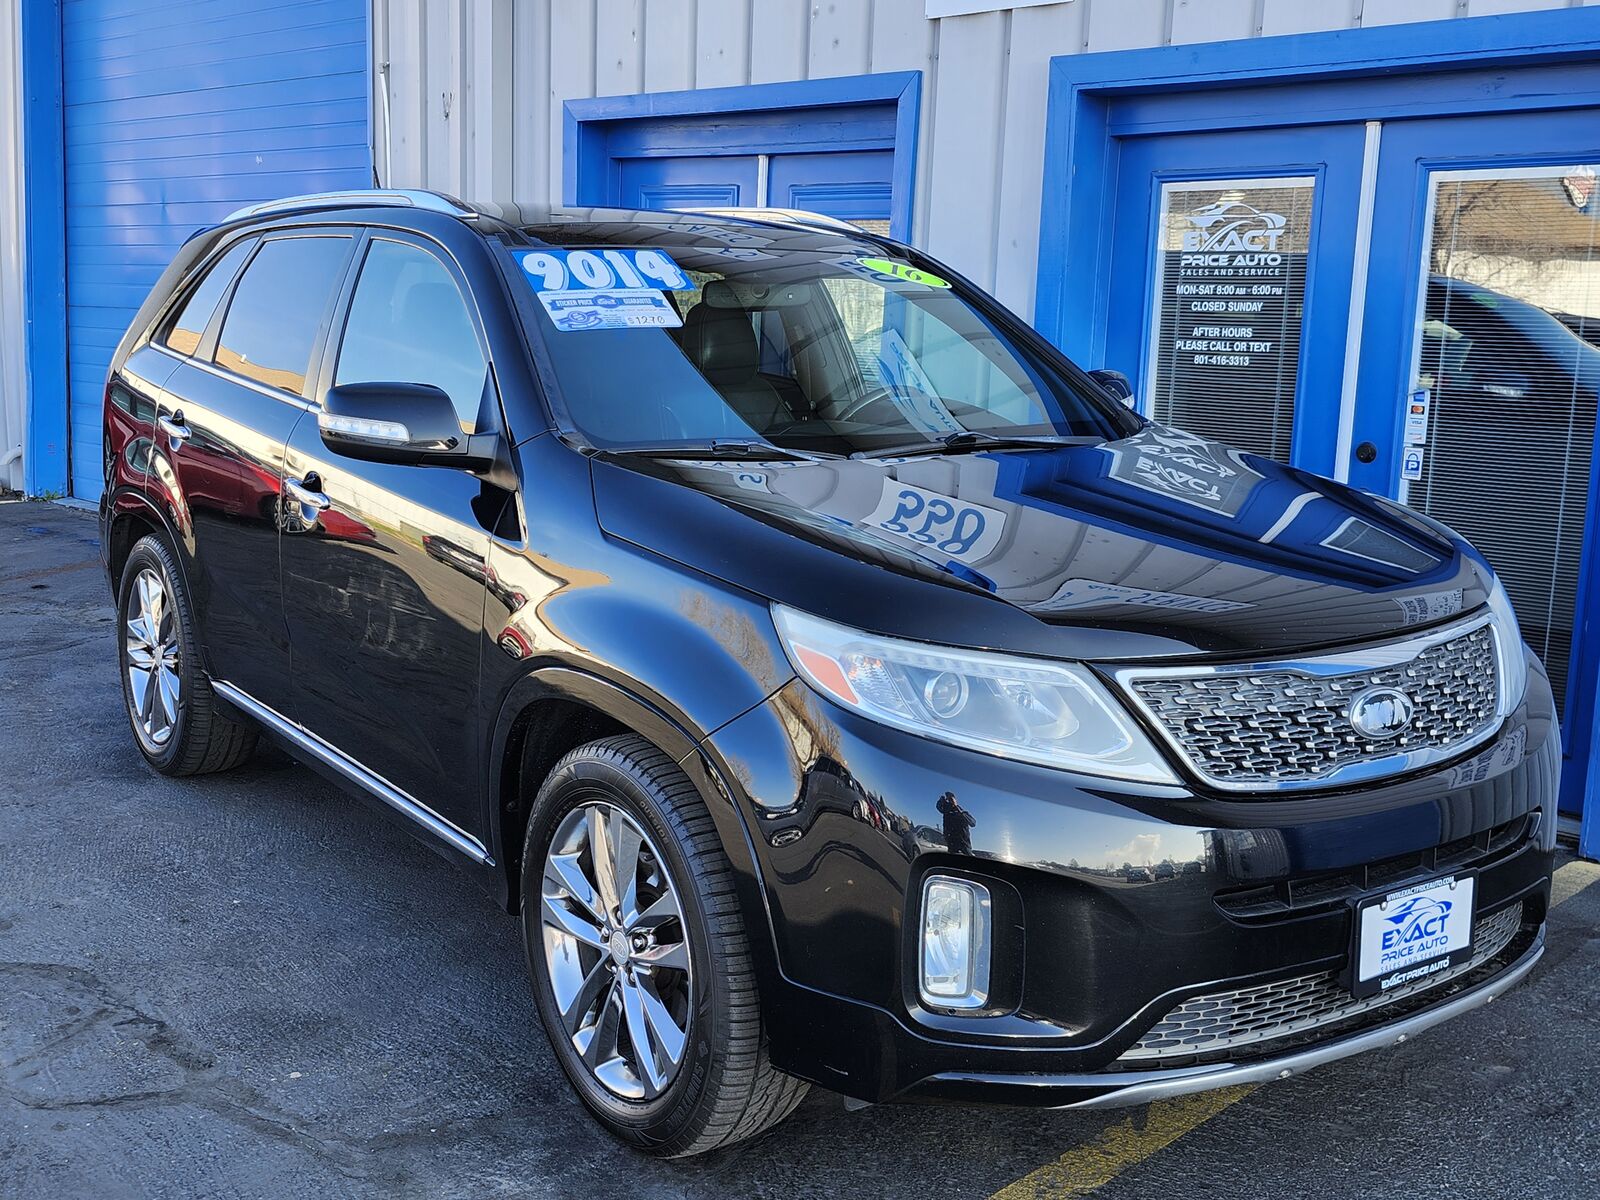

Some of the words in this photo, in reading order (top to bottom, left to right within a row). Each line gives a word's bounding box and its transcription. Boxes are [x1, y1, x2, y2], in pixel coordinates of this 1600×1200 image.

[1183, 229, 1285, 252] EXACT
[1180, 254, 1230, 267] PRICE
[1232, 253, 1281, 266] AUTO
[522, 250, 687, 291] 9014
[1180, 268, 1209, 276] SALES
[1213, 268, 1234, 276] AND
[1238, 268, 1280, 276] SERVICE
[1176, 284, 1215, 295] MON-SAT
[1216, 285, 1235, 295] 8:00
[1235, 287, 1246, 295] AM
[1252, 285, 1271, 295] 6:00
[1271, 287, 1282, 295] PM
[1191, 301, 1226, 312] CLOSED
[1228, 301, 1263, 312] SUNDAY
[1192, 327, 1221, 337] AFTER
[1222, 327, 1253, 338] HOURS
[1175, 341, 1209, 351] PLEASE
[1210, 341, 1232, 351] CALL
[1234, 341, 1247, 352] OR
[1249, 342, 1272, 352] TEXT
[1193, 354, 1250, 366] 801-416-3313
[1382, 913, 1450, 951] EXACT
[1381, 945, 1415, 964] PRICE
[1417, 935, 1449, 953] AUTO
